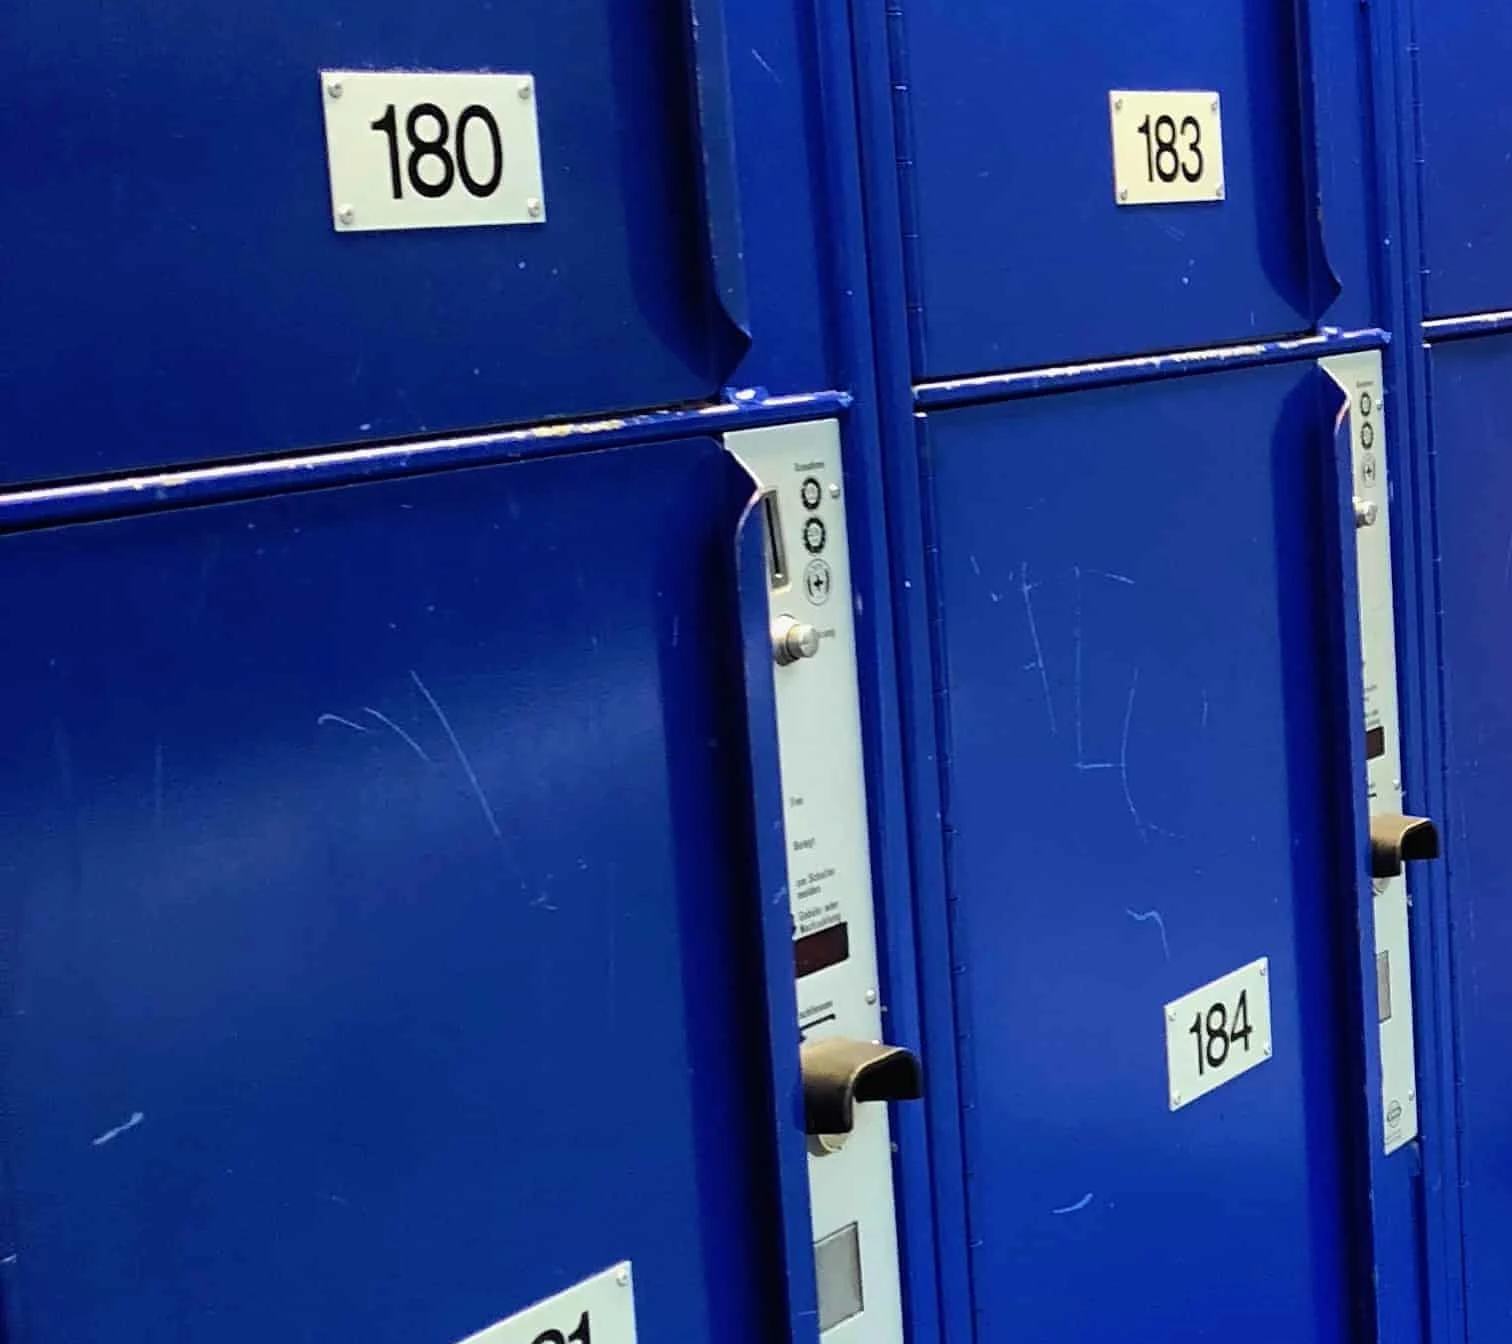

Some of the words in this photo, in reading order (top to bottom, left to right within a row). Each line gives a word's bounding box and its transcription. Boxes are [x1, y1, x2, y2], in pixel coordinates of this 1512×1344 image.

[370, 102, 504, 200] 180
[1137, 114, 1204, 183] 183
[1190, 989, 1254, 1076] 184
